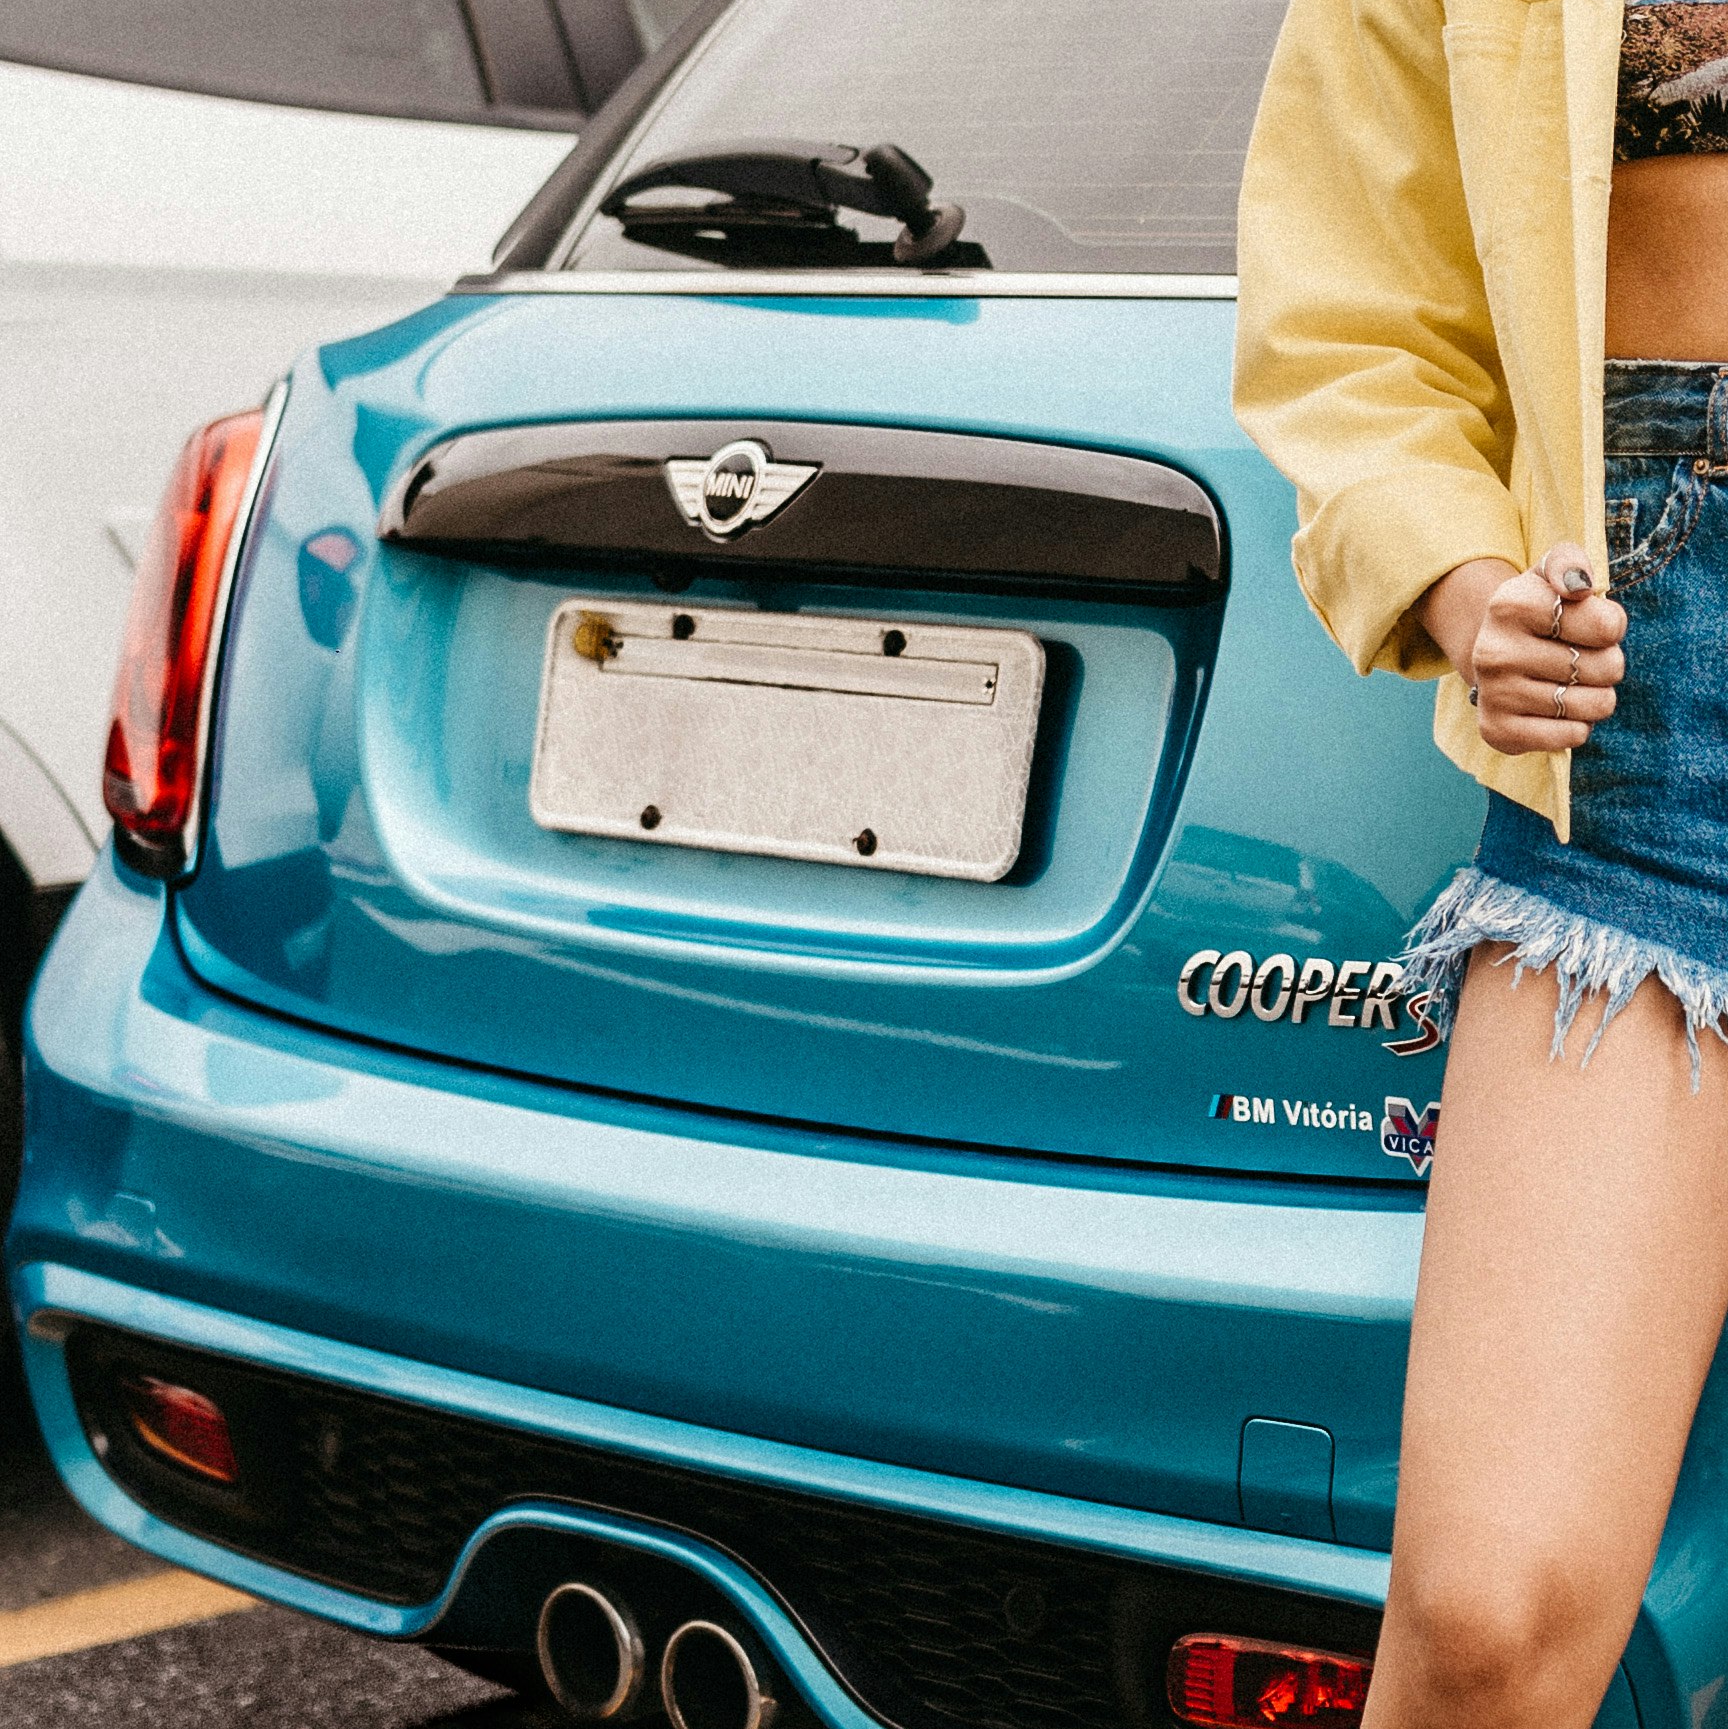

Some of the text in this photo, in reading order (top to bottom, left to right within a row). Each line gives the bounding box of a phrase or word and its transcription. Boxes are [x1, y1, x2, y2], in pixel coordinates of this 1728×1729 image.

[705, 472, 755, 500] MINI
[1177, 949, 1447, 1056] COOPER S
[1232, 1095, 1374, 1132] BM Vitória
